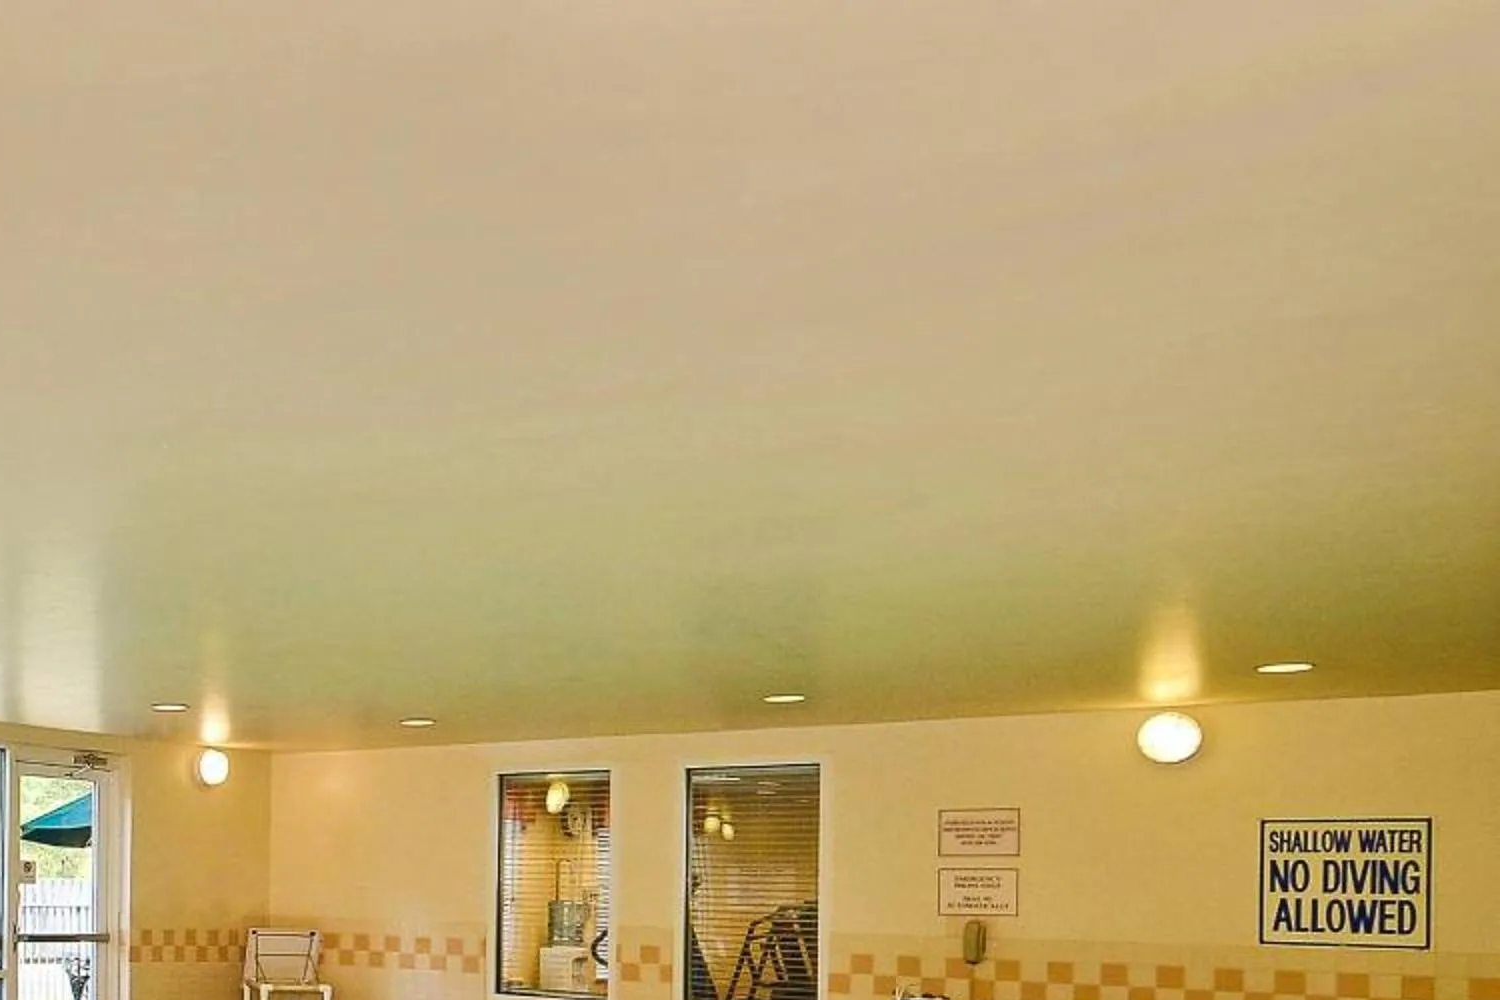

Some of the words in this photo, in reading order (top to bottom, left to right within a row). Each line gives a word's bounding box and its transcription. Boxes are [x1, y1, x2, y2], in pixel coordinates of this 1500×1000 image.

[1269, 830, 1352, 853] SHALLOW
[1358, 829, 1422, 853] WATER
[1269, 859, 1310, 893] NO
[1322, 859, 1421, 895] DIVING
[1273, 898, 1417, 935] ALLOWED
